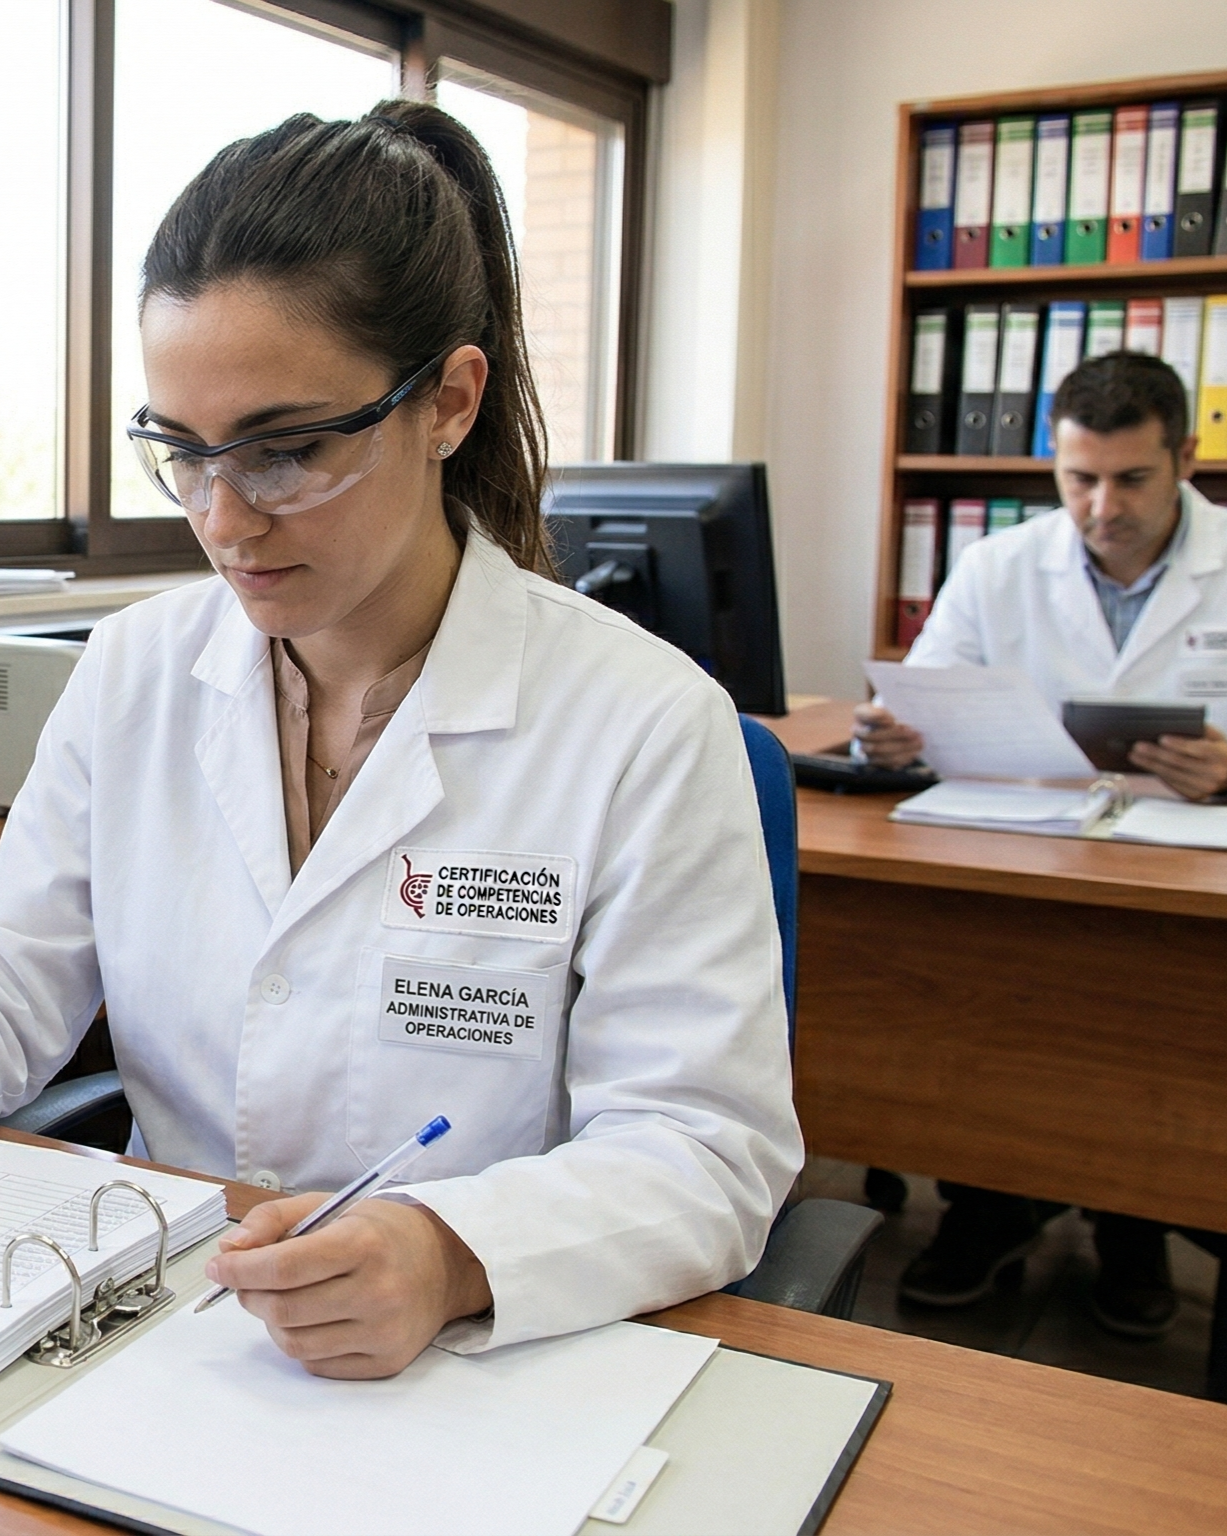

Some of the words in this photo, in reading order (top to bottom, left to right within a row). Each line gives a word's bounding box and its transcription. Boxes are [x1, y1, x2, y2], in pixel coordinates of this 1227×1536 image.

[438, 866, 560, 888] CERTIFICACIÓN
[437, 884, 454, 898] DE
[457, 885, 562, 906] COMPETENCIAS
[435, 901, 454, 916] DE
[457, 903, 558, 924] OPERACIONES
[394, 978, 454, 1001] ELENA
[458, 986, 530, 1009] GARCÍA
[386, 1001, 510, 1027] ADMINISTRATIVA
[514, 1014, 535, 1030] DE
[405, 1021, 514, 1045] OPERACIONES
